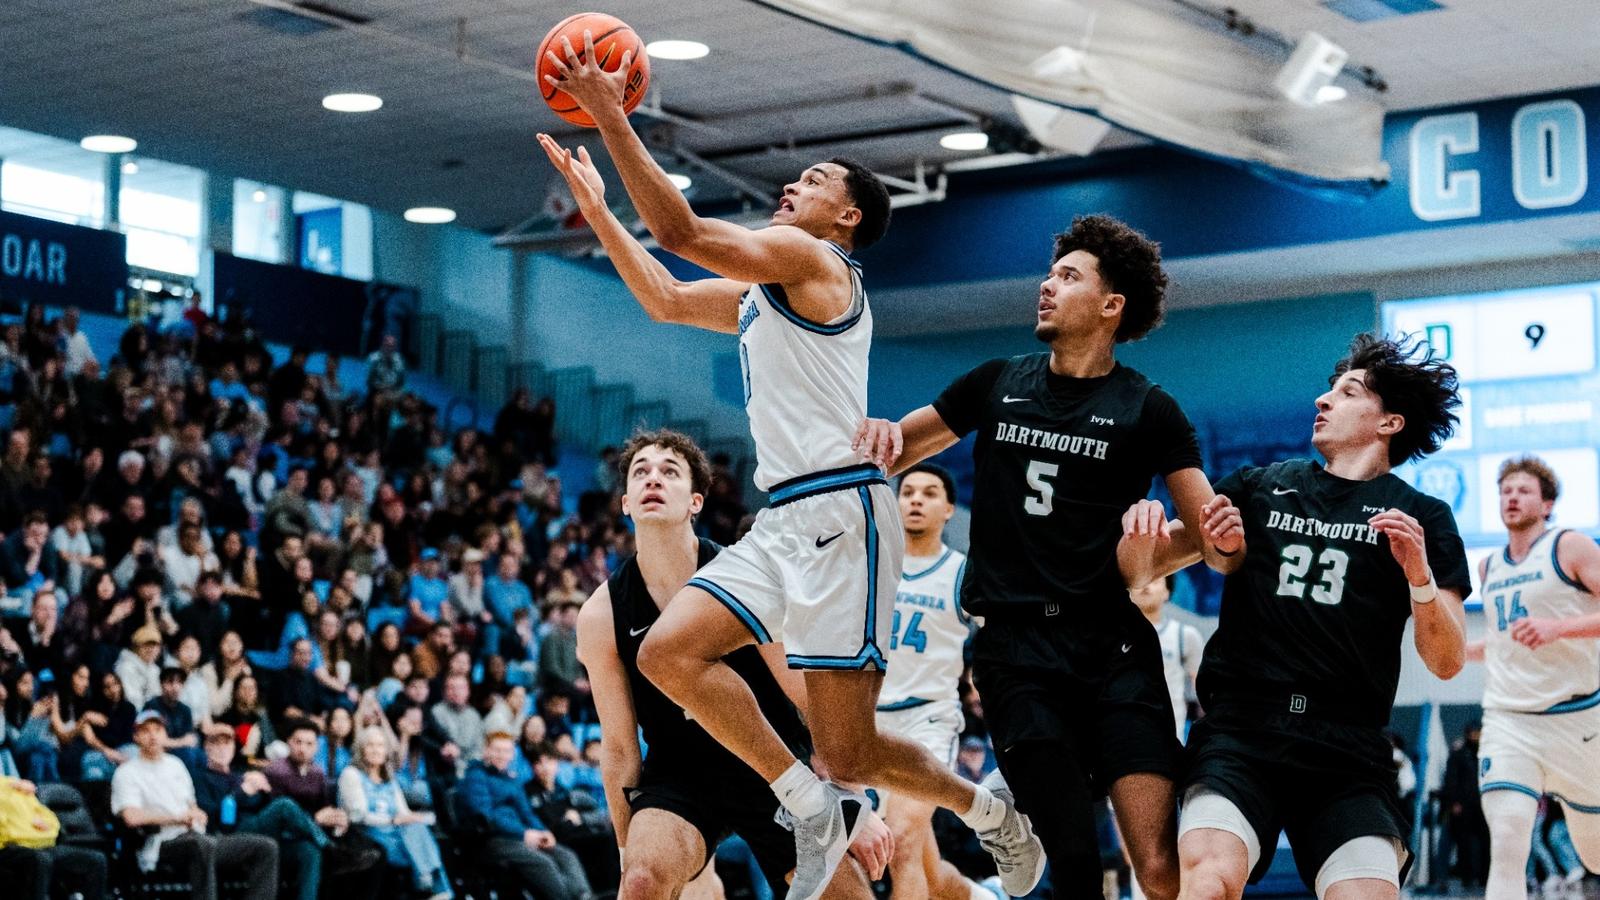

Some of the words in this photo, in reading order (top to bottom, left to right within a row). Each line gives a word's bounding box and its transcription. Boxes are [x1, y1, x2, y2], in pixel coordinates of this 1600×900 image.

[1525, 323, 1545, 350] 9
[1090, 415, 1107, 426] Ivy
[995, 421, 1110, 460] DARTMOUTH
[1024, 459, 1059, 516] 5
[1266, 510, 1379, 545] DARTMOUTH
[1276, 543, 1350, 605] 23
[1494, 590, 1529, 632] 14
[1290, 694, 1307, 713] D
